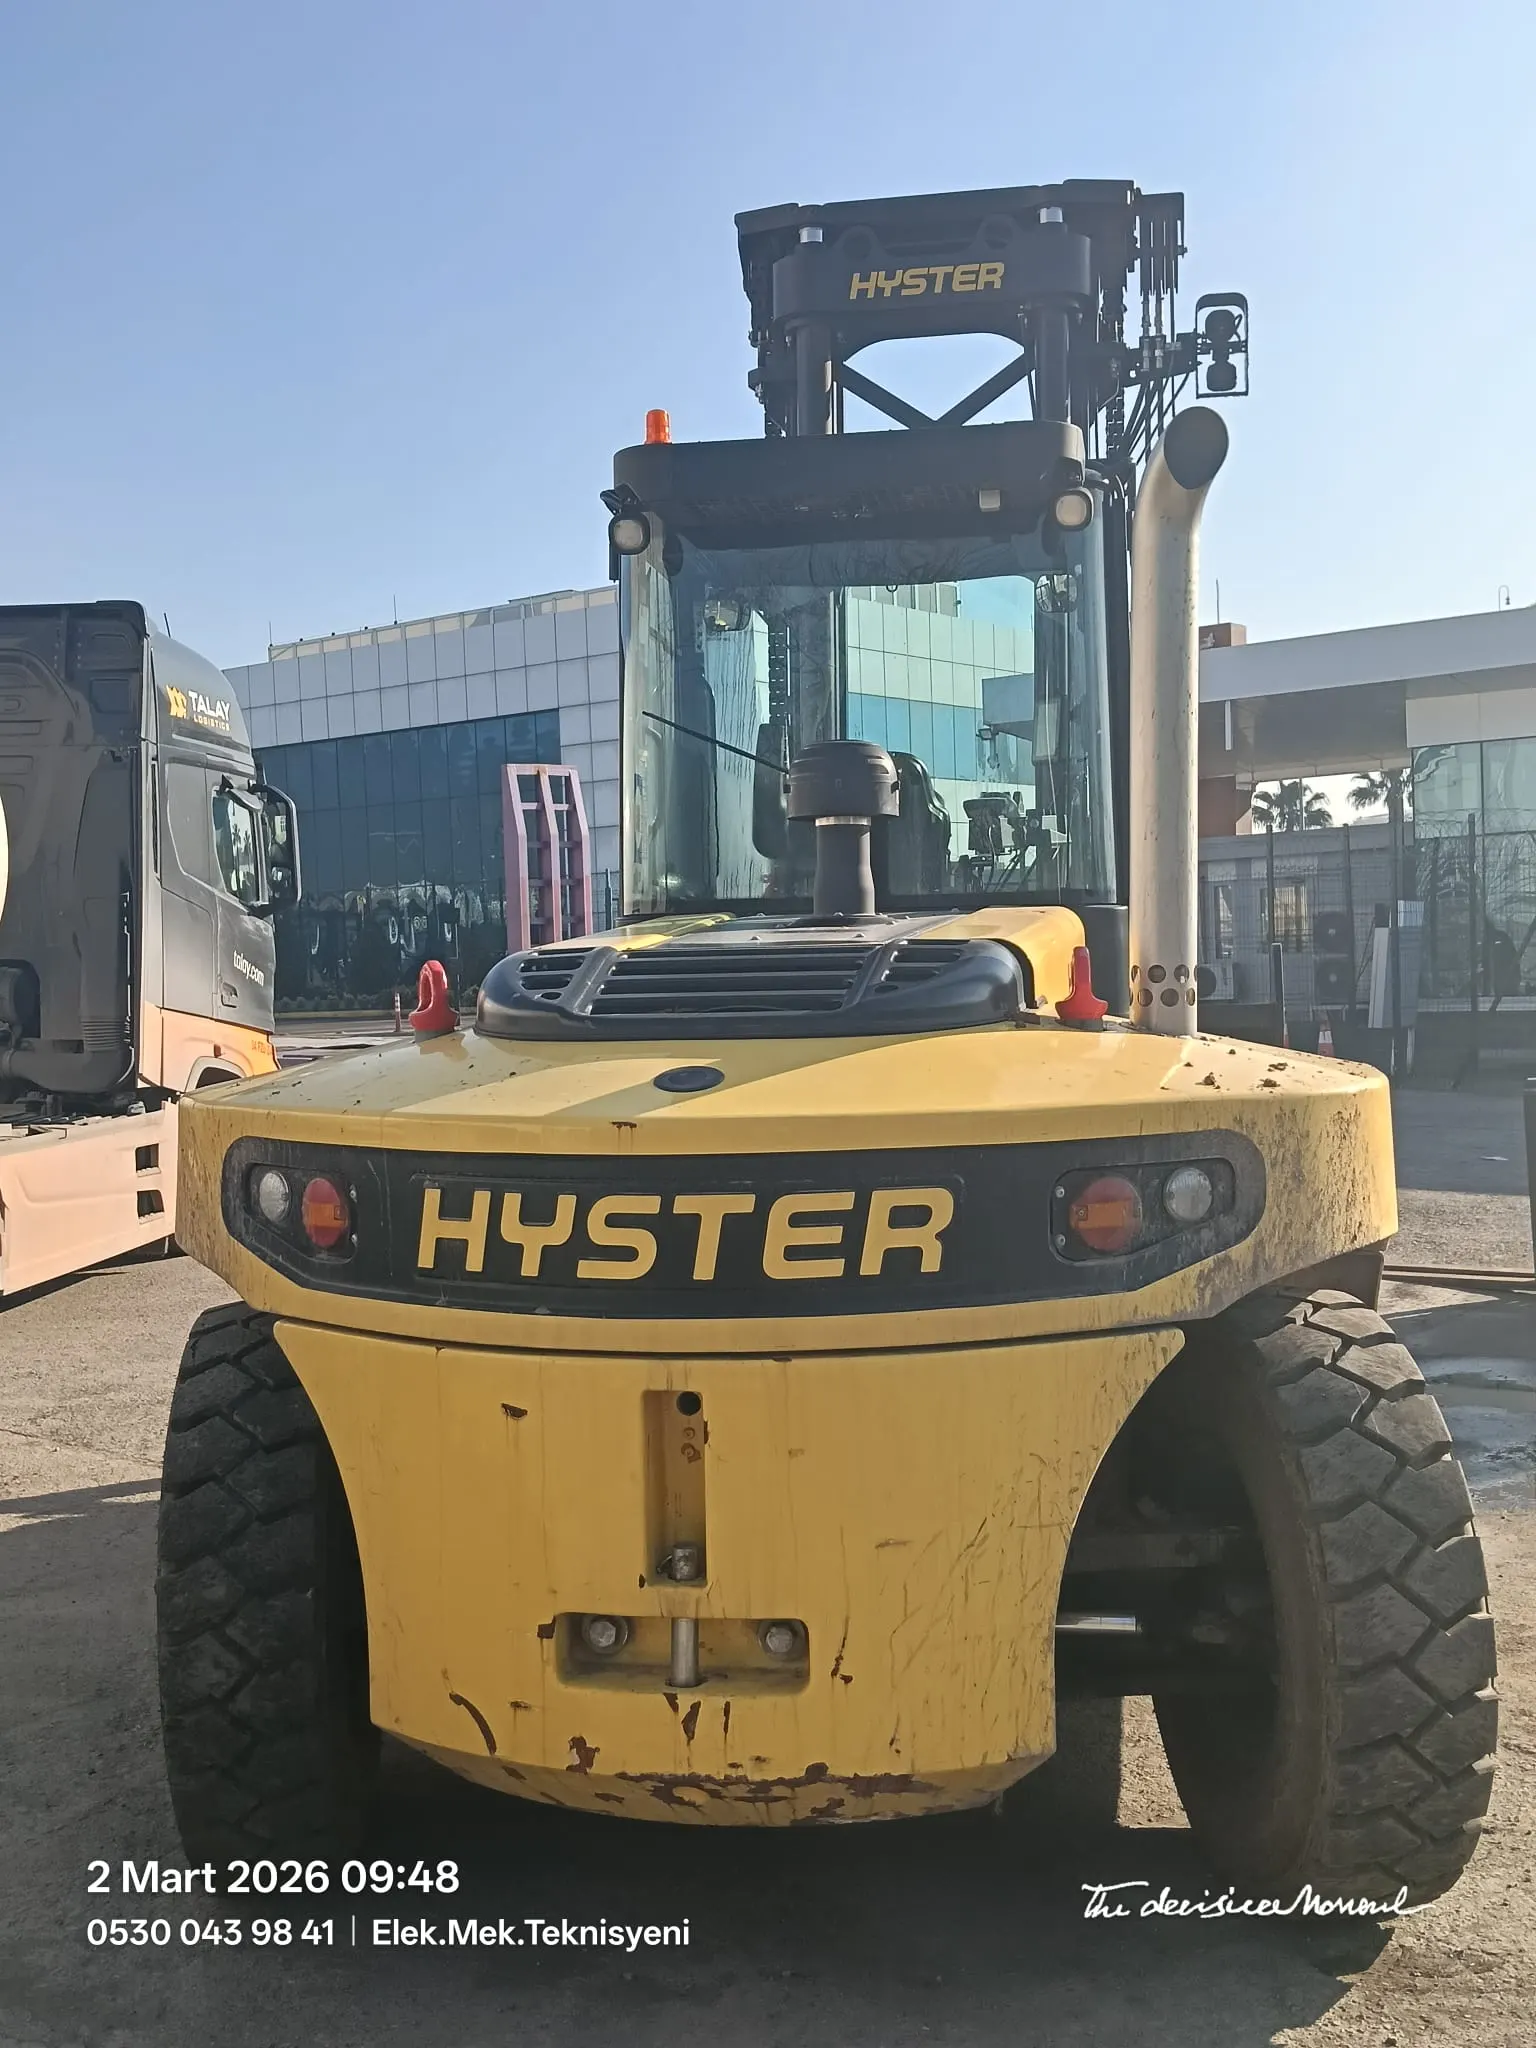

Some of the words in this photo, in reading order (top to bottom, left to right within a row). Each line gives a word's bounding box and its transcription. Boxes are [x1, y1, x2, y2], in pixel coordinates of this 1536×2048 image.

[850, 262, 1004, 300] HYSTER
[188, 690, 230, 721] TALAY
[193, 714, 230, 731] LOGISTICS
[233, 949, 265, 987] talay.com
[417, 1187, 954, 1281] HYSTER
